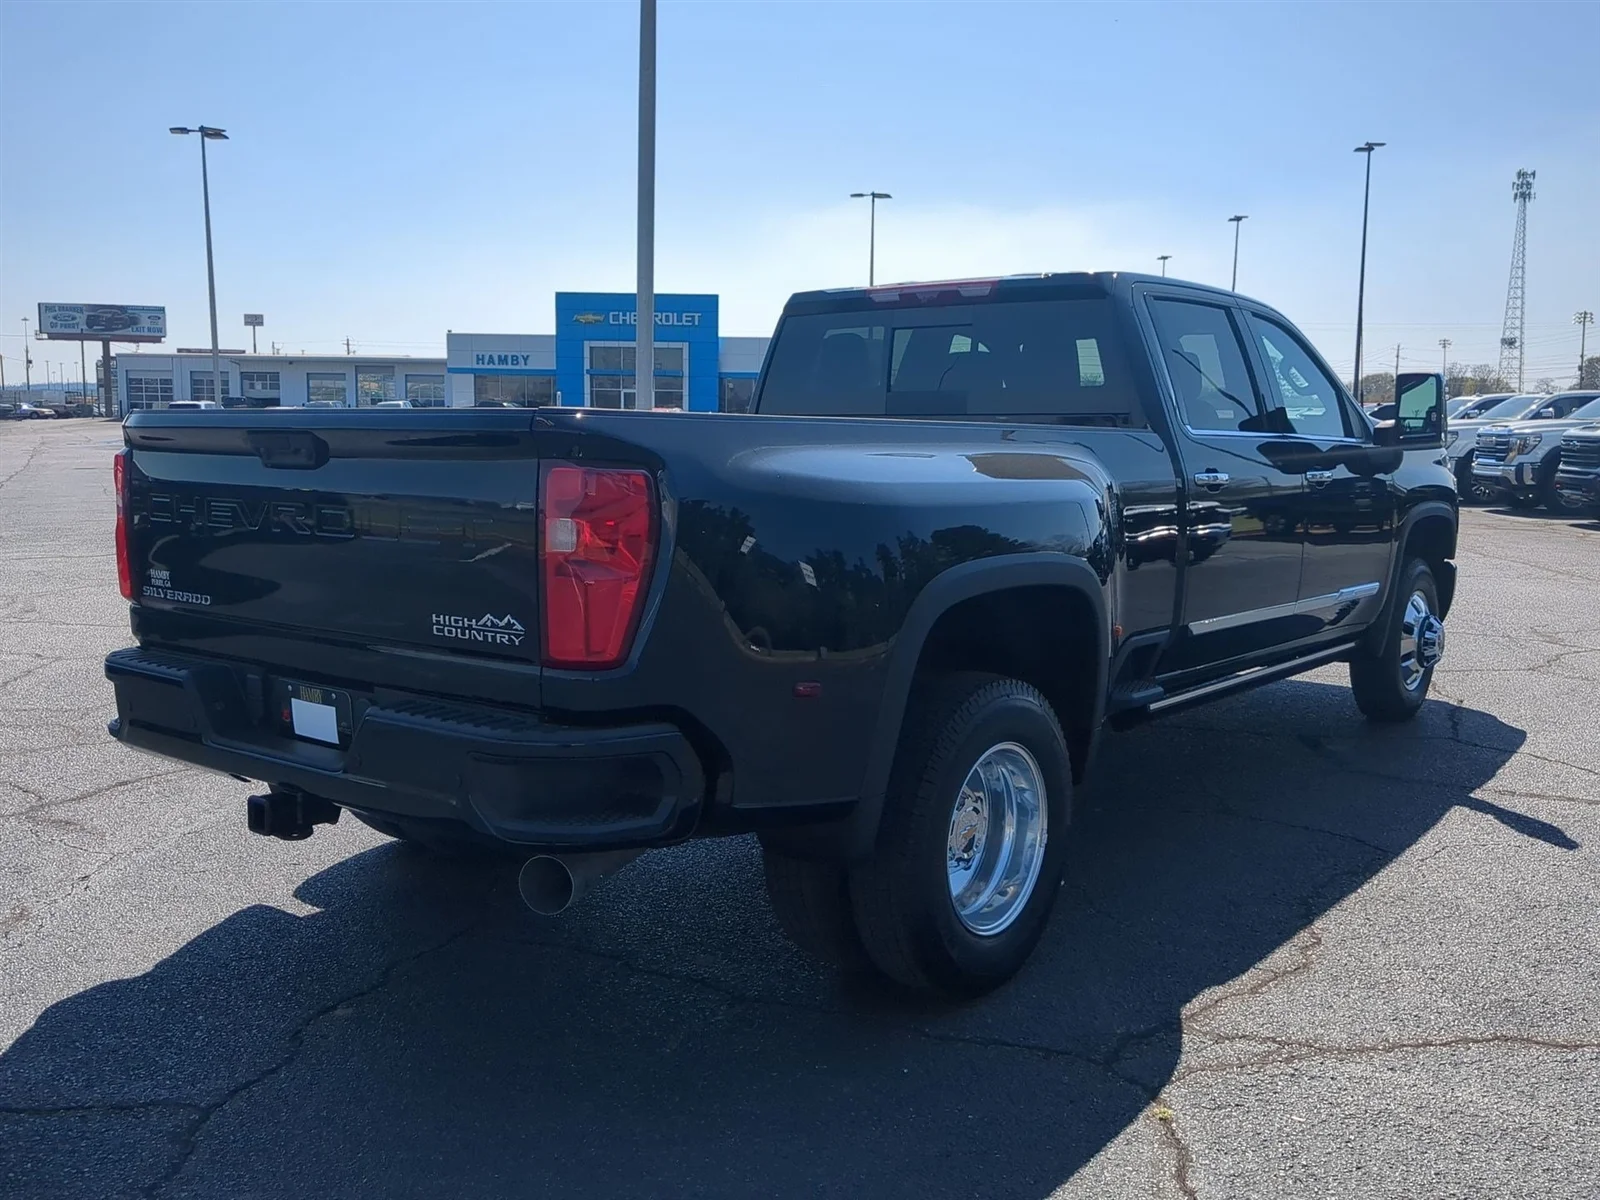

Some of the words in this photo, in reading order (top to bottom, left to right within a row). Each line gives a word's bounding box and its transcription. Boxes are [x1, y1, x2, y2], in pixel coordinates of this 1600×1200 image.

[609, 311, 702, 325] CHEROLET
[475, 353, 530, 366] HAMBY
[150, 568, 171, 580] HAMBY
[142, 585, 211, 606] SILVERADO
[432, 613, 477, 628] HIGH
[433, 625, 525, 646] COUNTRY
